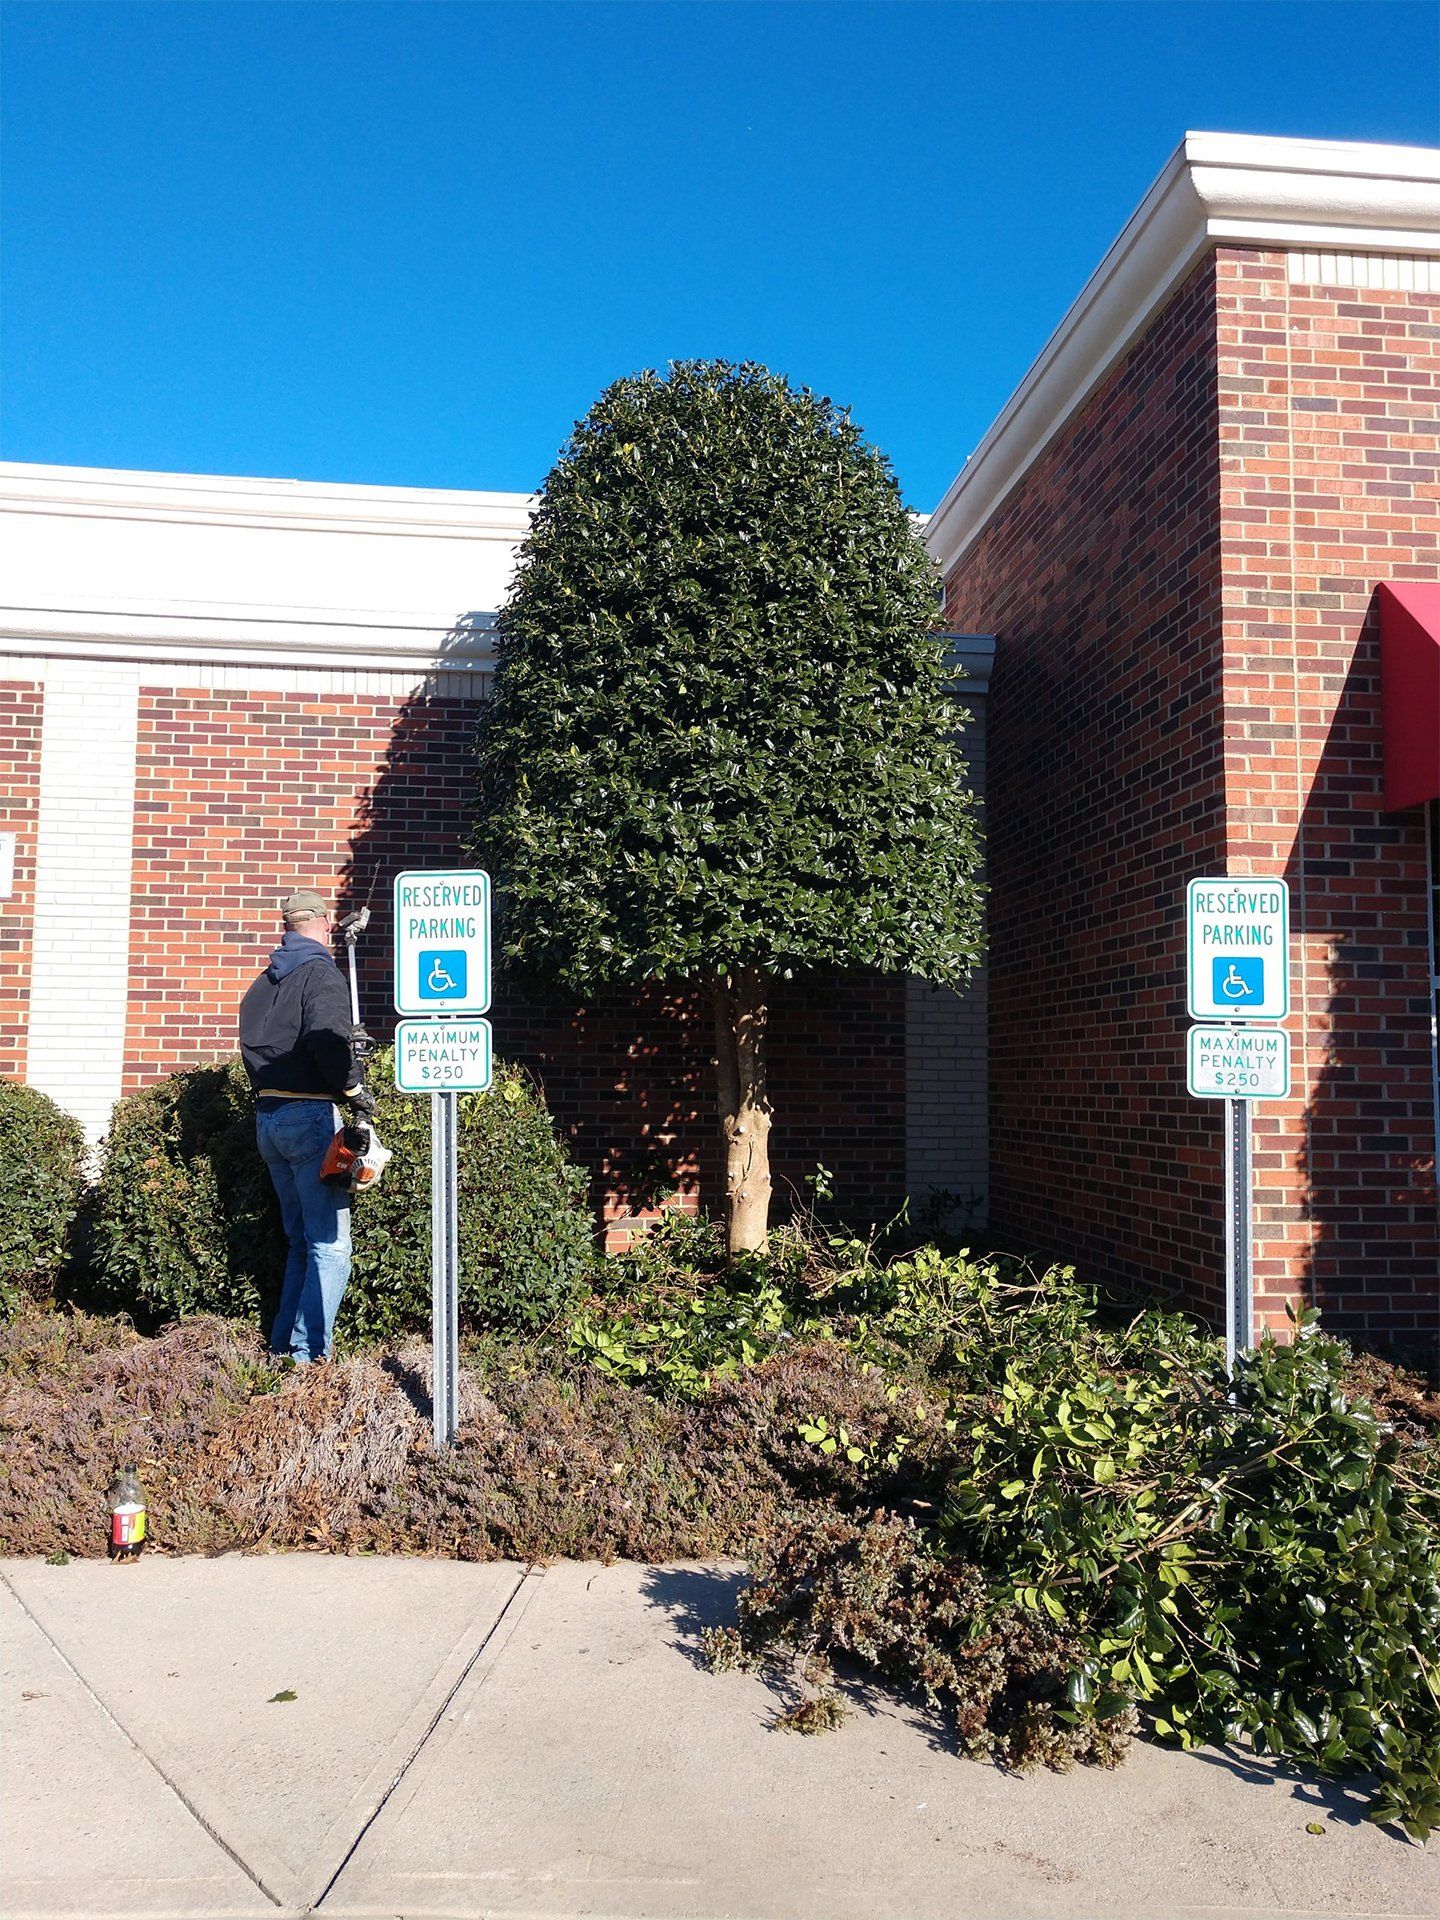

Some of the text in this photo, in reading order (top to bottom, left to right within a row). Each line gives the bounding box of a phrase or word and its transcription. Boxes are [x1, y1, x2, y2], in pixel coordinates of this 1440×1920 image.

[403, 885, 482, 907] RESERVED
[1196, 892, 1280, 914] RESERVED
[409, 917, 476, 939] PARKING
[1203, 924, 1273, 946] PARKING
[407, 1031, 480, 1045] MAXIMUM
[1200, 1037, 1278, 1052] MAXIMUM
[408, 1048, 479, 1062] PENALTY
[1201, 1054, 1276, 1070] PENALTY
[421, 1065, 464, 1079] $250
[1215, 1072, 1260, 1087] $250
